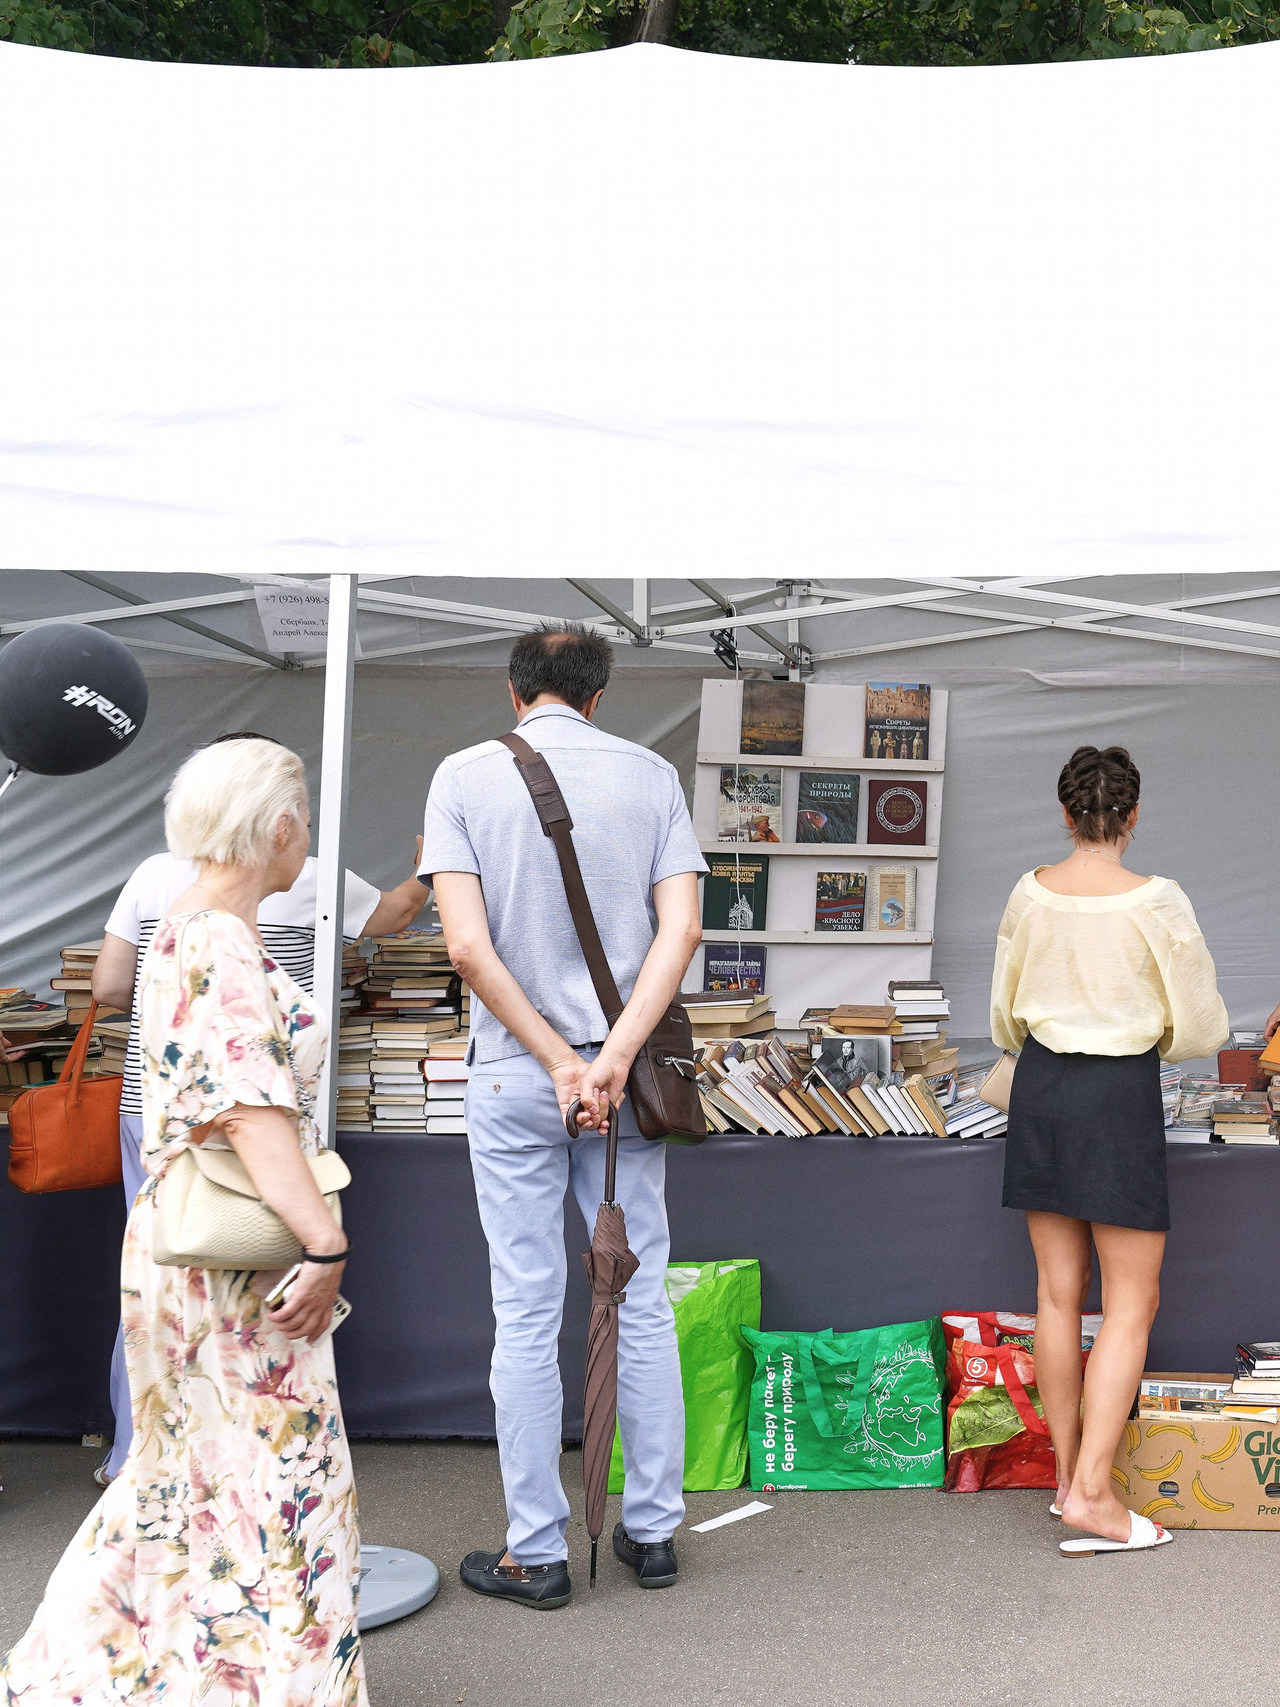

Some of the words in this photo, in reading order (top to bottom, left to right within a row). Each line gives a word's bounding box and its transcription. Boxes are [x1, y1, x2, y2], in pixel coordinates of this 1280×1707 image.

[264, 595, 276, 604] +7
[279, 595, 303, 604] (926)
[304, 596, 329, 604] 498-5
[280, 618, 319, 626] Сбербанк,
[272, 628, 302, 637] Андрей
[812, 782, 851, 790] СЕКРЕТЫ
[810, 790, 852, 799] ПРИРОДЫ
[971, 1358, 984, 1374] 5
[764, 1366, 776, 1408] пакет
[782, 1352, 796, 1414] природу
[763, 1412, 778, 1448] беру
[782, 1416, 797, 1472] берегу
[765, 1452, 776, 1472] не
